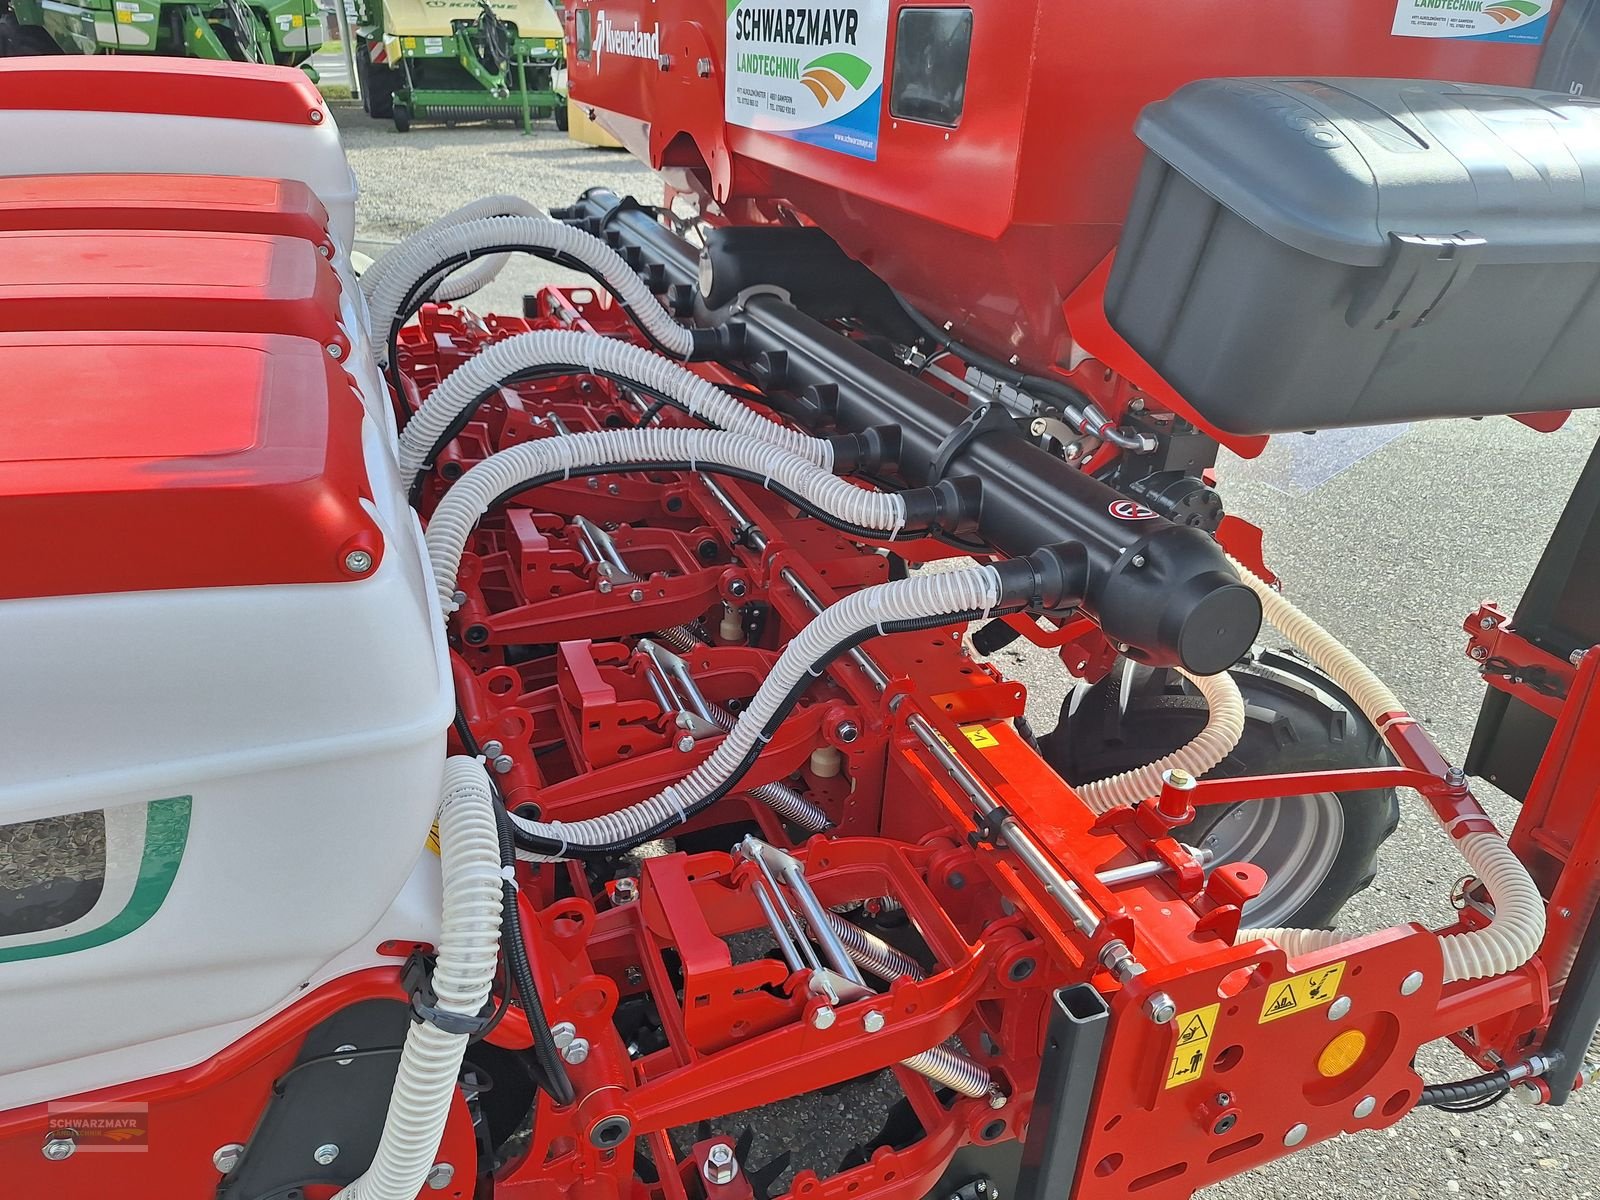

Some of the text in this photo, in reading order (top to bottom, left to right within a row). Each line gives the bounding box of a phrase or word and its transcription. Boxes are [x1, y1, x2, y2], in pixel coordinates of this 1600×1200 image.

[1414, 0, 1483, 12] LANDTECHNIK
[606, 20, 659, 60] Kverneland
[736, 8, 858, 46] SCHWARZMAYR
[736, 52, 800, 80] LANDTECHNIK
